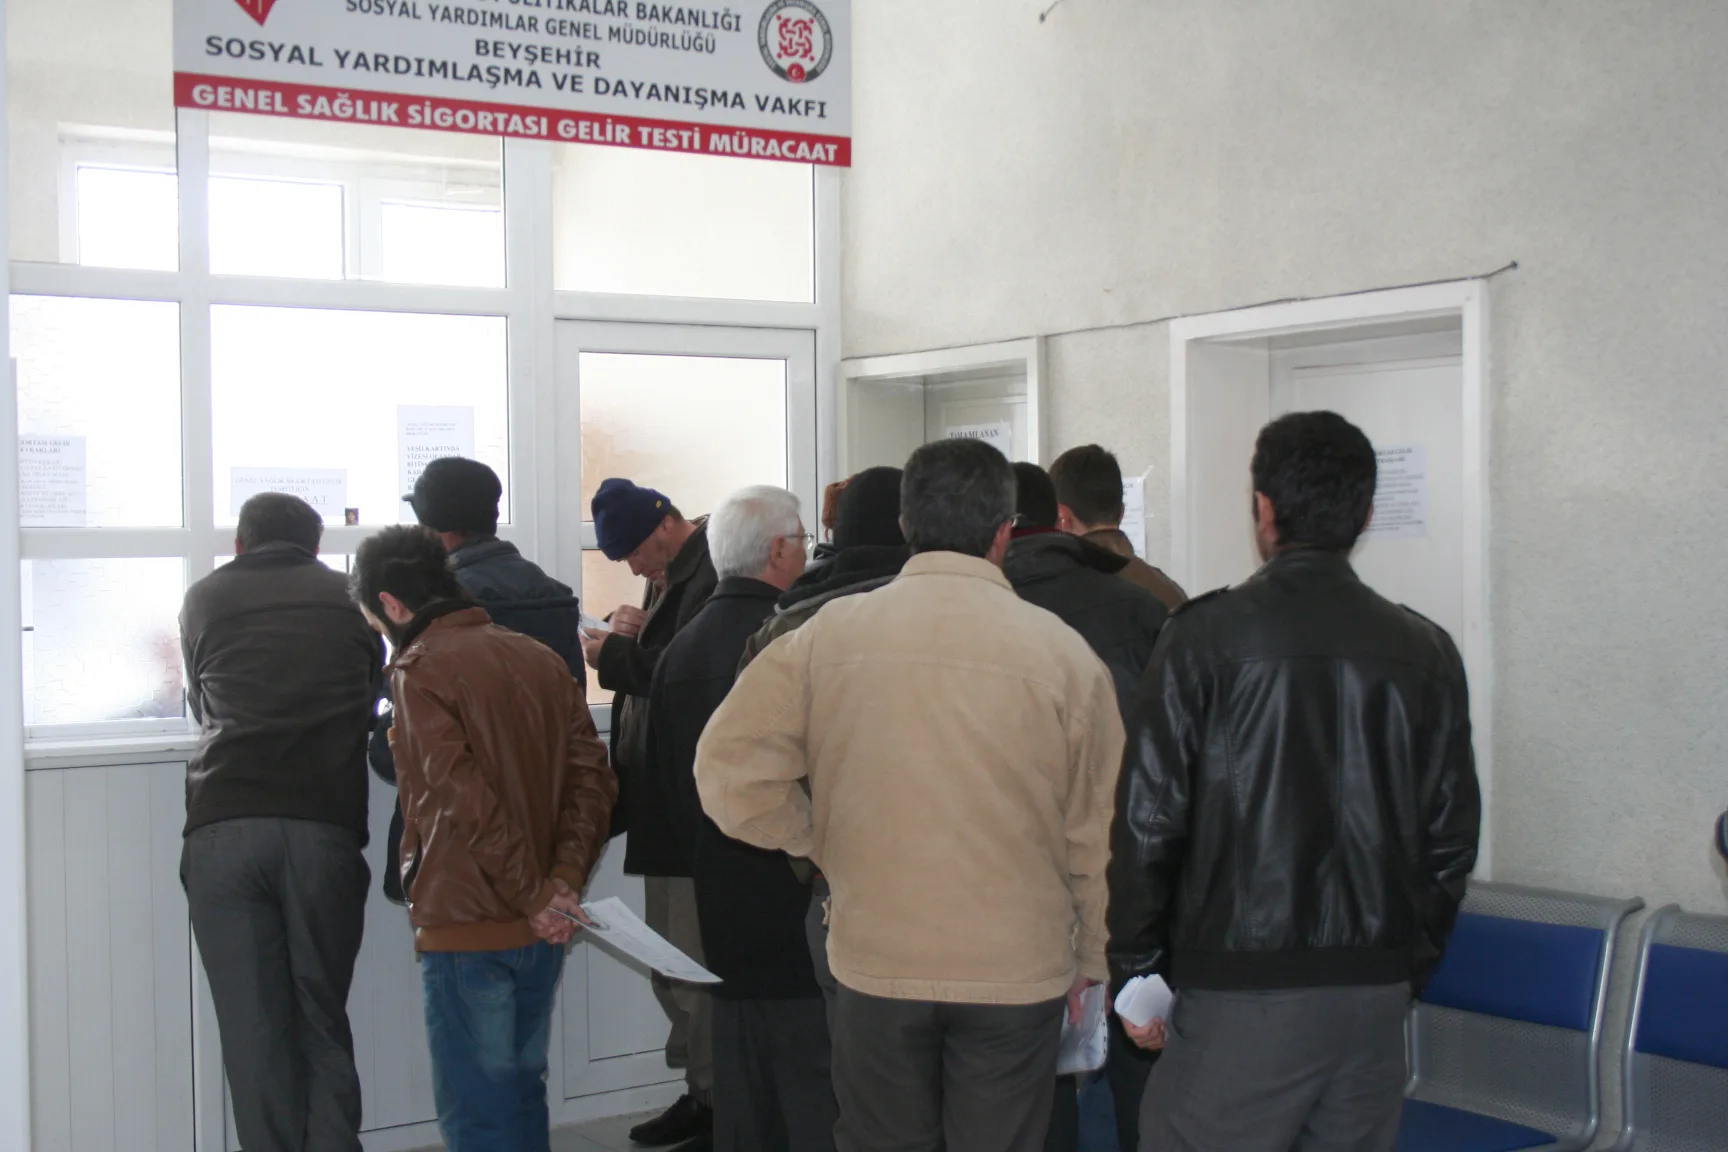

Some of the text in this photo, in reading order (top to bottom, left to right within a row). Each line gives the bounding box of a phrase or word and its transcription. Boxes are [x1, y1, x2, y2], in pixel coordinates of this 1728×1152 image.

[346, 0, 715, 54] SOSYAL YARDIMLAR GENEL MÜDÜRLÜĞÜ
[636, 2, 741, 32] BAKANLIĞI
[205, 35, 827, 119] SOSYAL YARDIMLAŞMA VE DAYANIŞMA VAKFI
[475, 39, 600, 69] BEYŞEHİR
[191, 83, 838, 162] GENEL SAĞLIK SİGORTASI GELİR TESTİ MÜRACAAT
